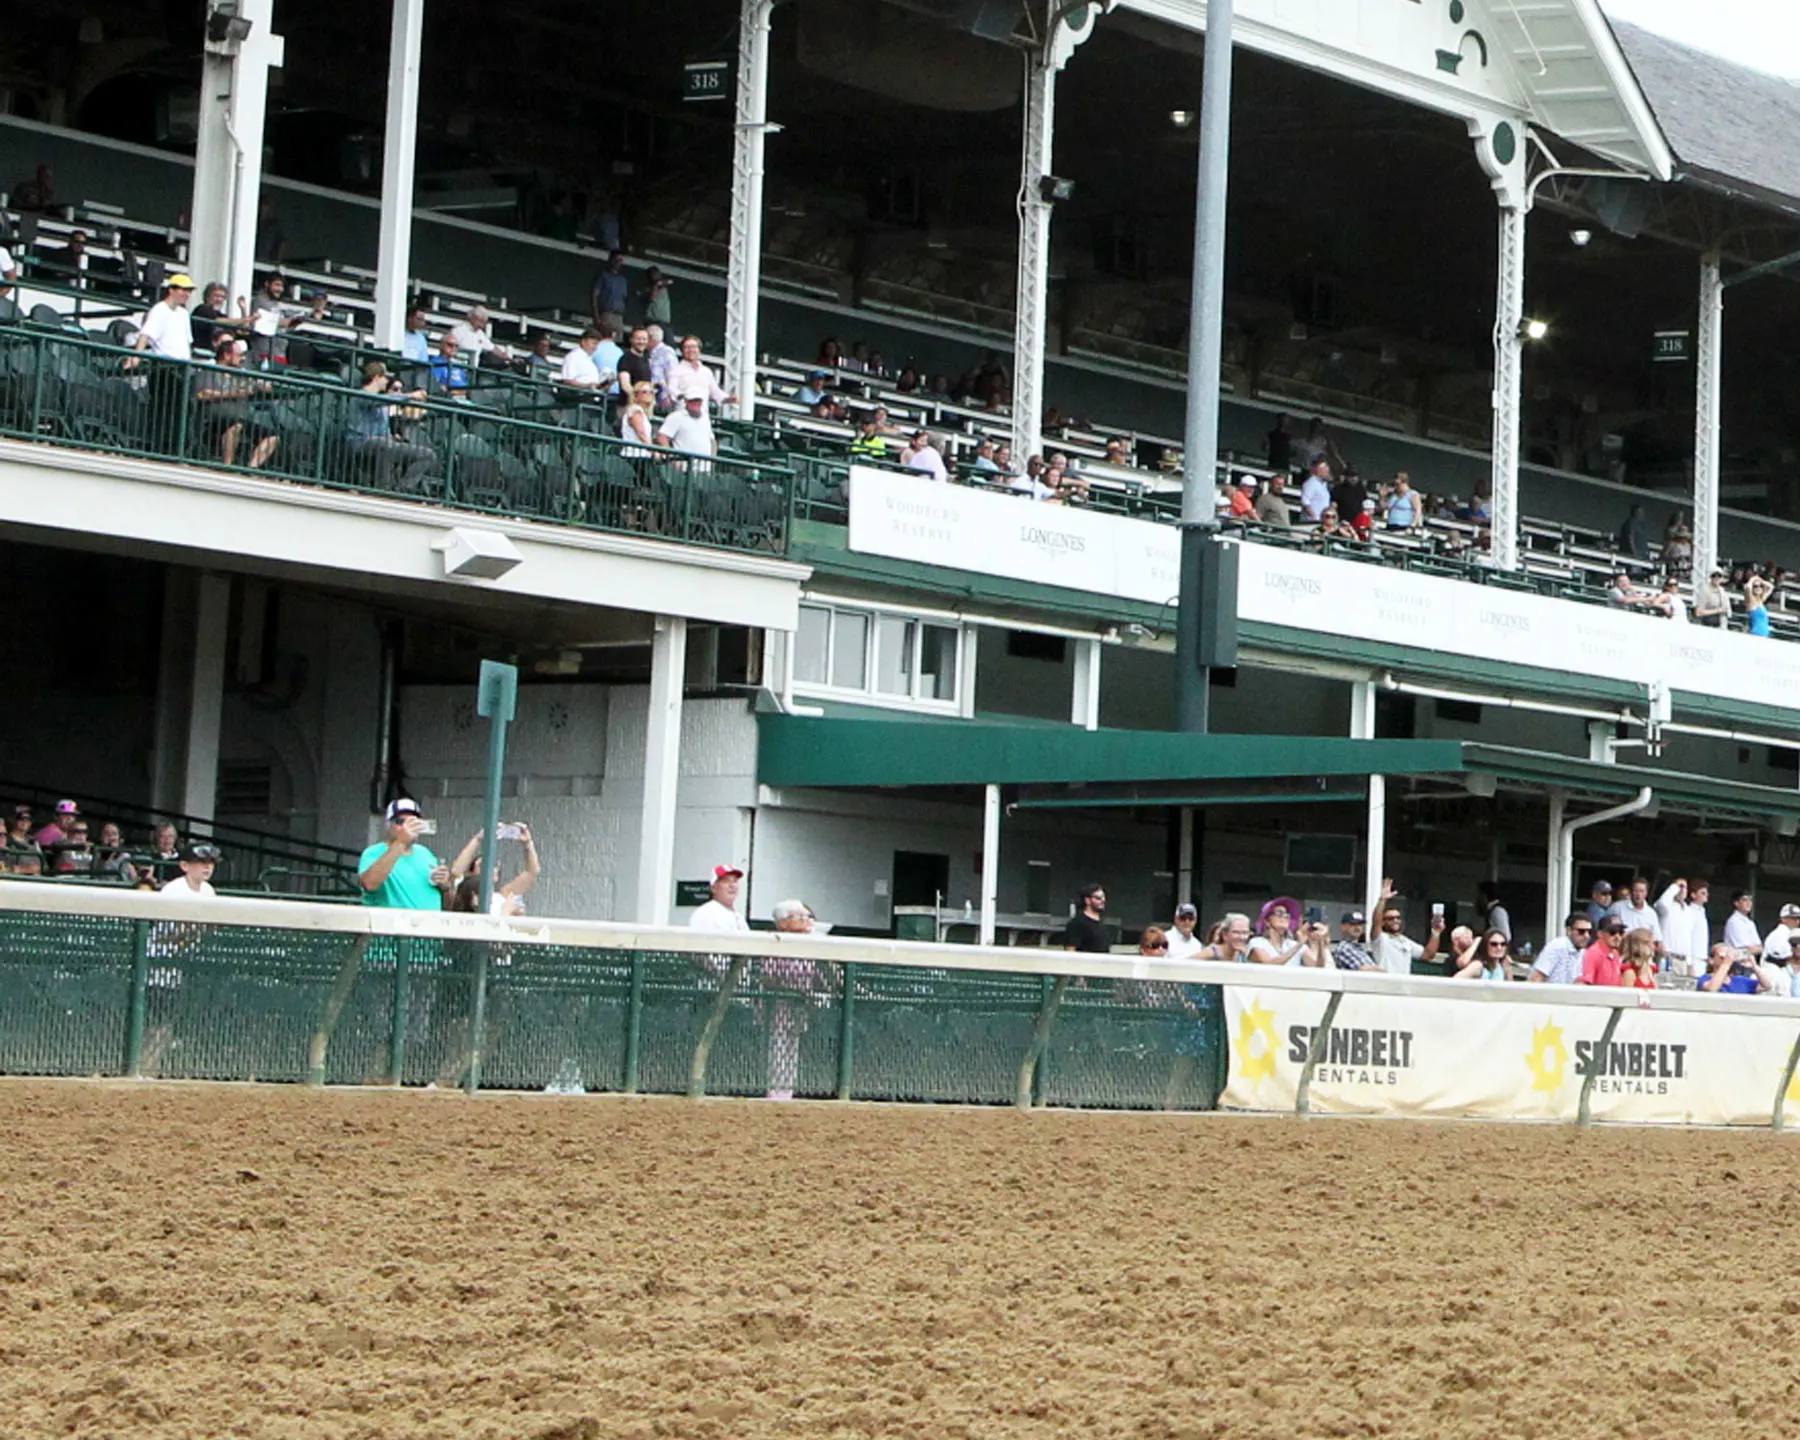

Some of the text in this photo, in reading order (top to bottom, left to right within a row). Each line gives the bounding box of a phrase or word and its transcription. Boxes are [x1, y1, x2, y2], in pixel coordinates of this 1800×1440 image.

[691, 72, 719, 90] 318
[1020, 525, 1086, 553] LONGINES
[1264, 570, 1322, 595] LONGINES
[1288, 1025, 1413, 1067] SUNBELT
[1575, 1040, 1686, 1078] SUNBELT
[1318, 1068, 1397, 1085] ENTALS
